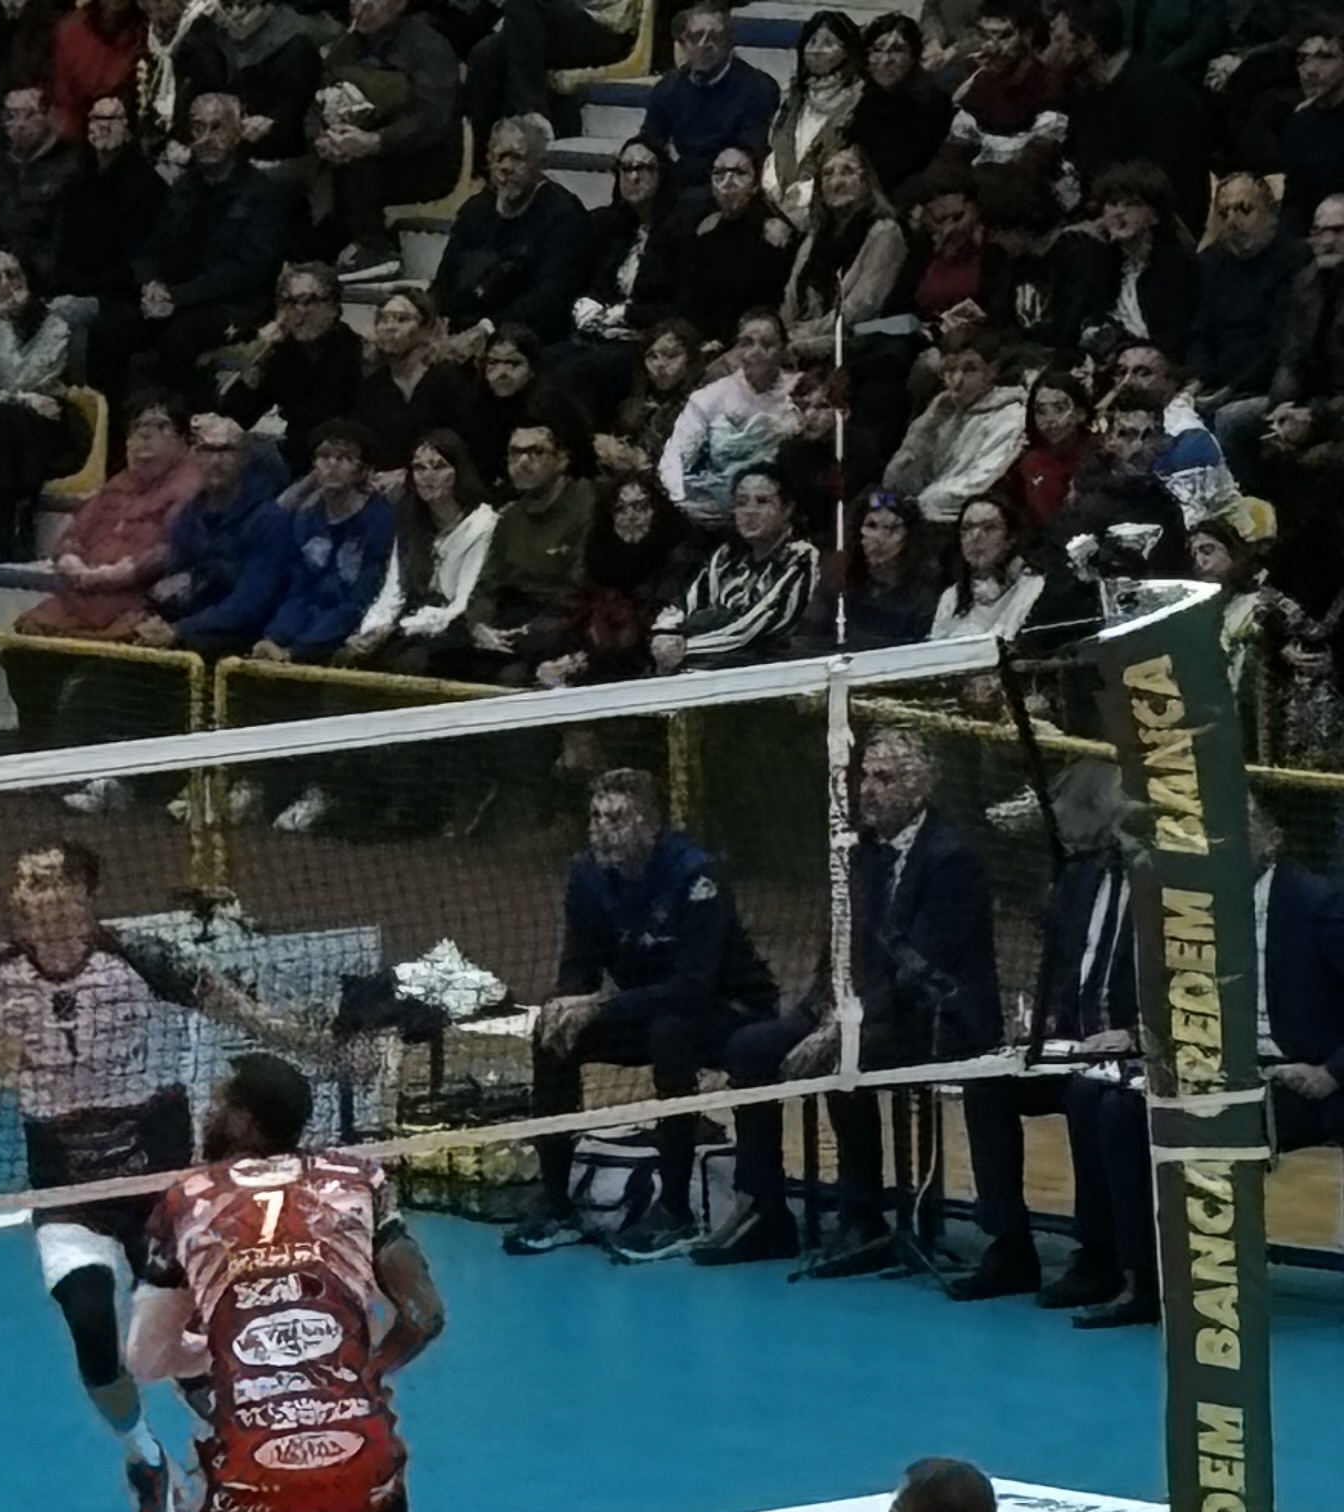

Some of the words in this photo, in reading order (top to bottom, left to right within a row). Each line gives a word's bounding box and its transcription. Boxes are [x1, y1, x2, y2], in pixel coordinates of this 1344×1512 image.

[1122, 653, 1210, 856] BANCA
[253, 1190, 284, 1244] 7
[1181, 1160, 1242, 1371] BANCA
